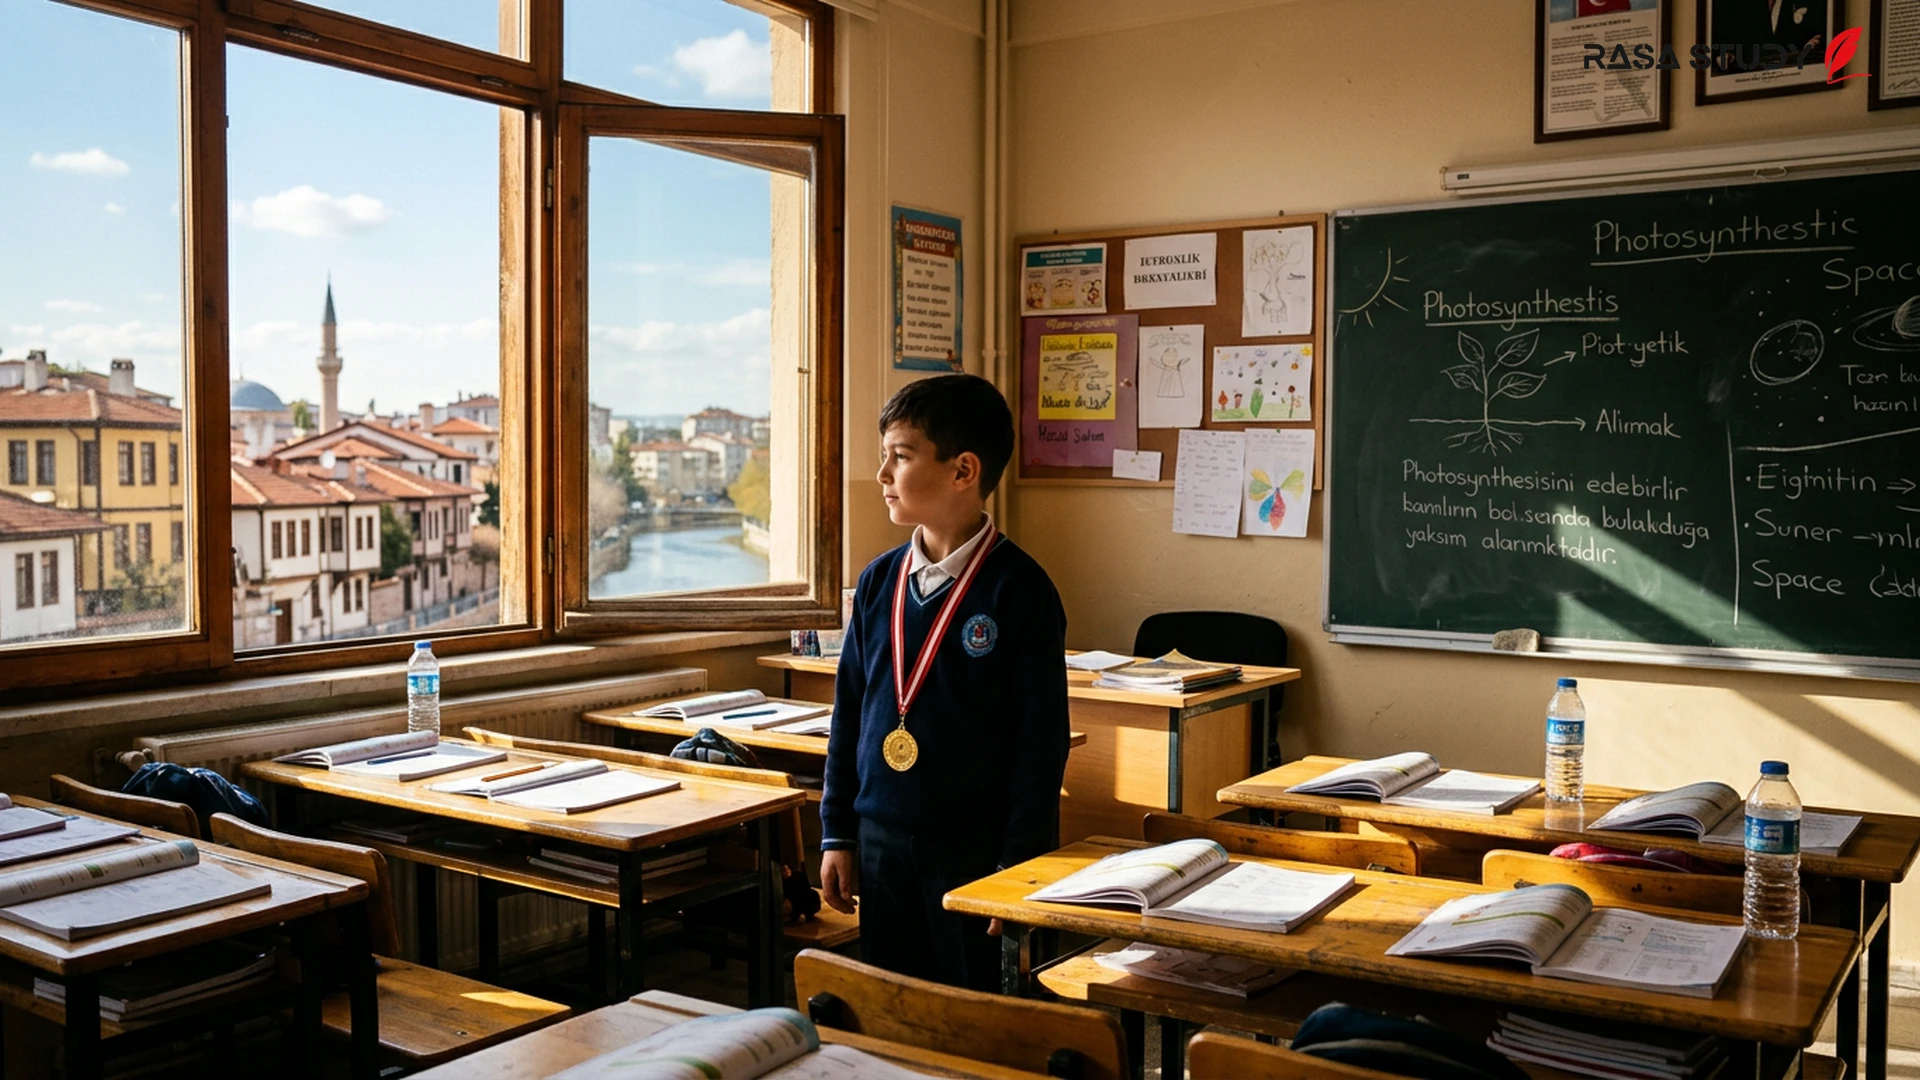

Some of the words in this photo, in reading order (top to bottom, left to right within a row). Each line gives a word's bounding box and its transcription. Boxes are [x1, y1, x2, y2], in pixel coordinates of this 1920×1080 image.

[1593, 208, 1859, 263] Photosynthestic
[1424, 285, 1619, 331] Photosynthestis
[1586, 471, 1689, 501] edebirlir
[1752, 558, 1846, 600] Space
